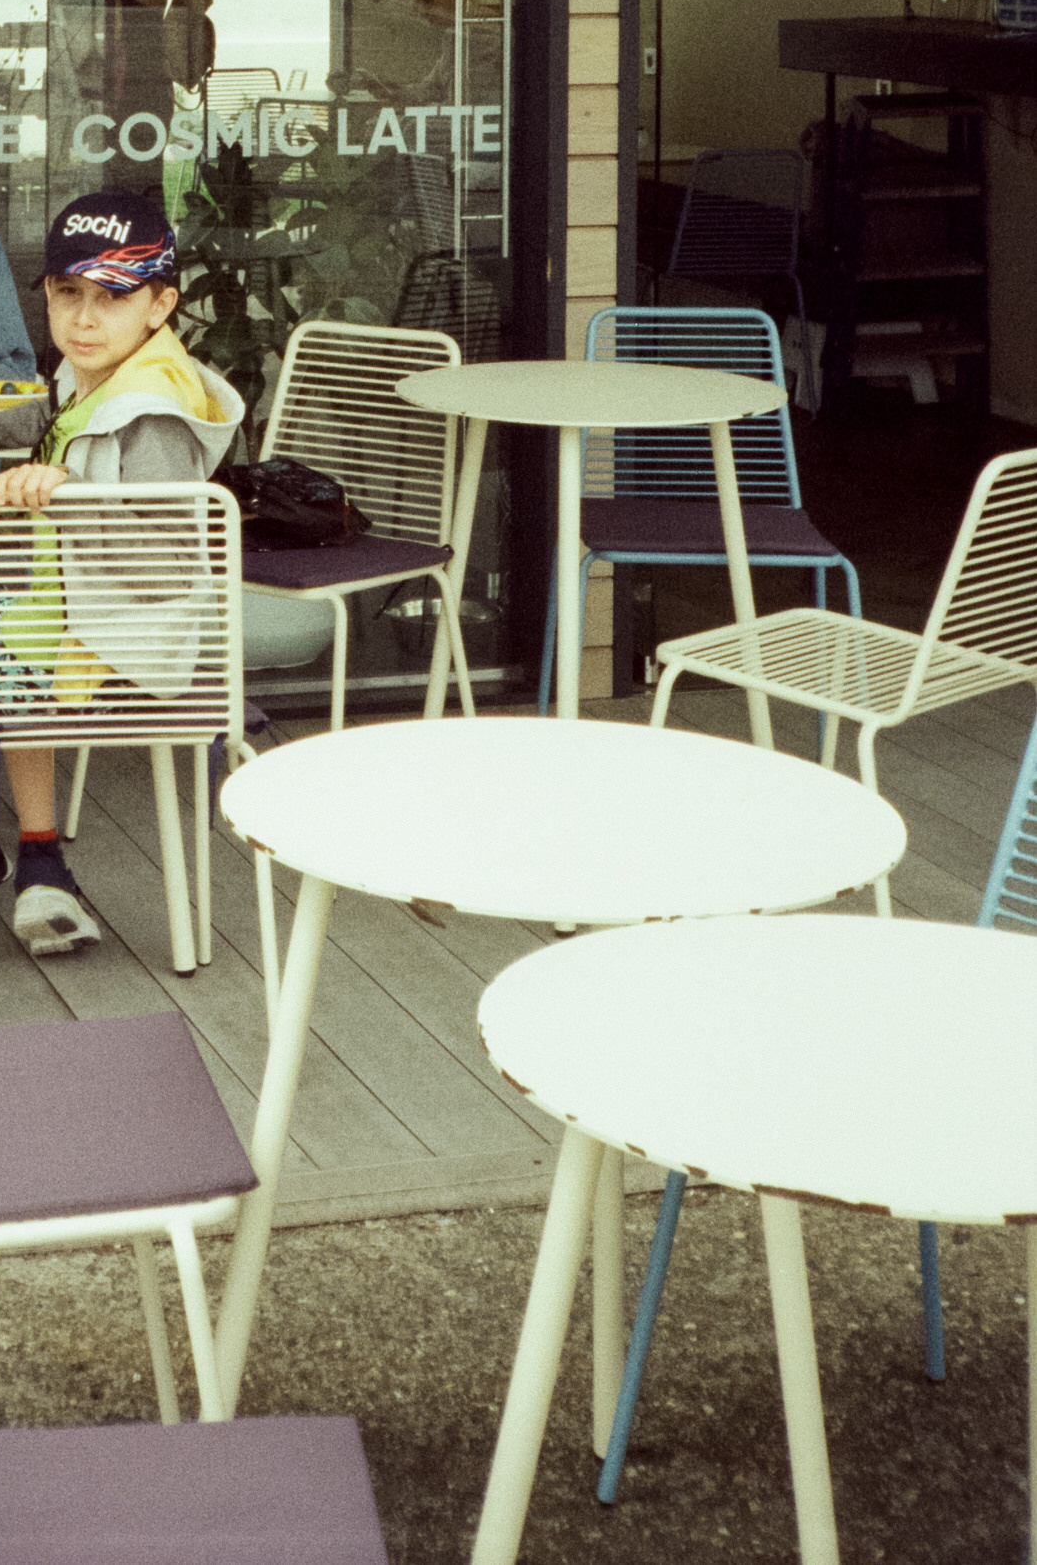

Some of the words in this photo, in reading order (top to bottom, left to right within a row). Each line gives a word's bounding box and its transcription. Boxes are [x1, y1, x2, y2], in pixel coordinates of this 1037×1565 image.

[73, 111, 318, 164] COSMIC
[337, 105, 502, 156] LATTE
[63, 213, 132, 244] sochi
